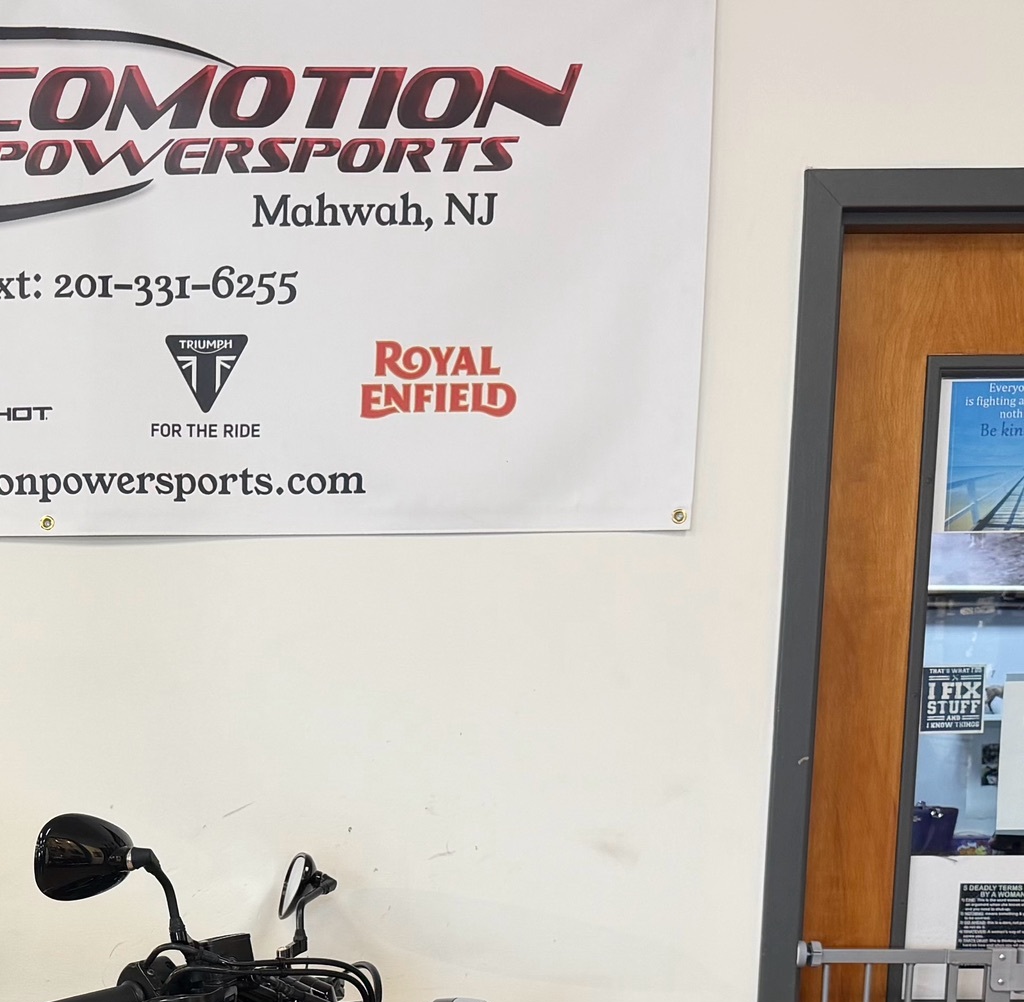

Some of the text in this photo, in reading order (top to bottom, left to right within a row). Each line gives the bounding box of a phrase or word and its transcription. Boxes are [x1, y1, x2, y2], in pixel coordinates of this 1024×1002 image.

[252, 192, 498, 231] Mahwah, NJ
[55, 266, 298, 306] 201-331-6255
[179, 339, 233, 350] TRIUMPH
[374, 341, 501, 380] ROYAL
[361, 383, 517, 419] ENFIELD
[965, 396, 974, 406] is
[976, 395, 1016, 408] fighting
[151, 423, 261, 438] FOR THE RIDE
[980, 421, 1024, 437] Be kin
[927, 681, 982, 700] I FIX
[927, 700, 981, 715] STUFF
